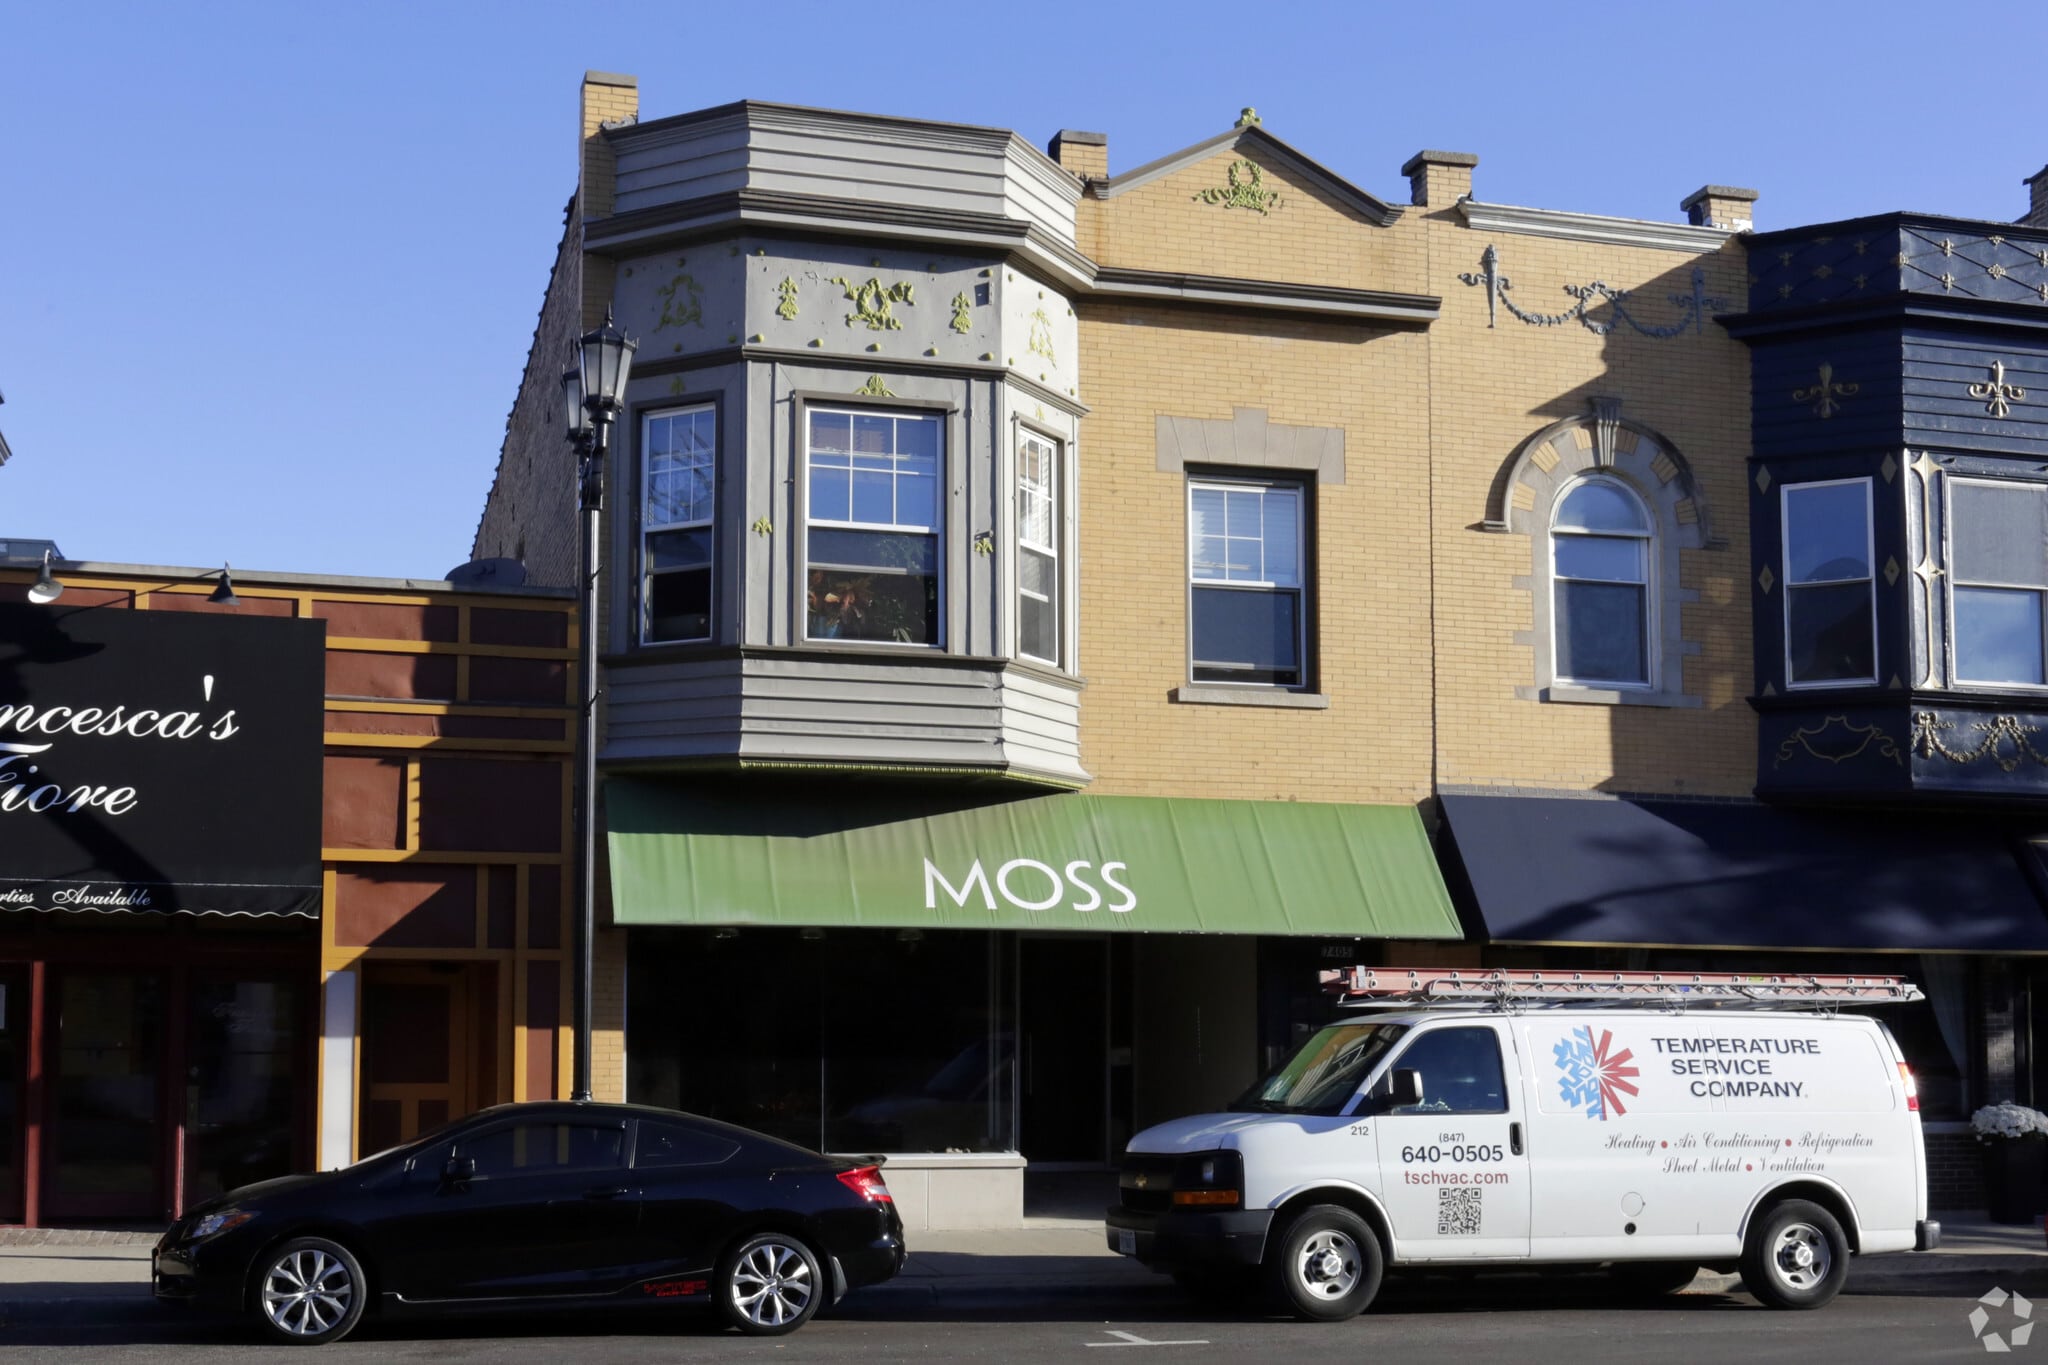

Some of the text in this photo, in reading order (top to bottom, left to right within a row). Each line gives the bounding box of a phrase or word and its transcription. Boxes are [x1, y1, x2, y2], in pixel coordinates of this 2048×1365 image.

[924, 857, 1137, 912] MOSS
[52, 884, 151, 906] Available
[1651, 1037, 1821, 1055] TEMPERATURE
[1671, 1058, 1773, 1075] SERVICE
[1690, 1080, 1804, 1097] COMPANY
[1351, 1126, 1369, 1136] 212
[1438, 1132, 1465, 1143] (847)
[1604, 1131, 1873, 1156] Heating Air Conditioning Refrigeration
[1401, 1145, 1503, 1163] 640-0505
[1662, 1156, 1825, 1173] Sheet Metal Ventilation
[1404, 1170, 1509, 1185] tschvac.com
